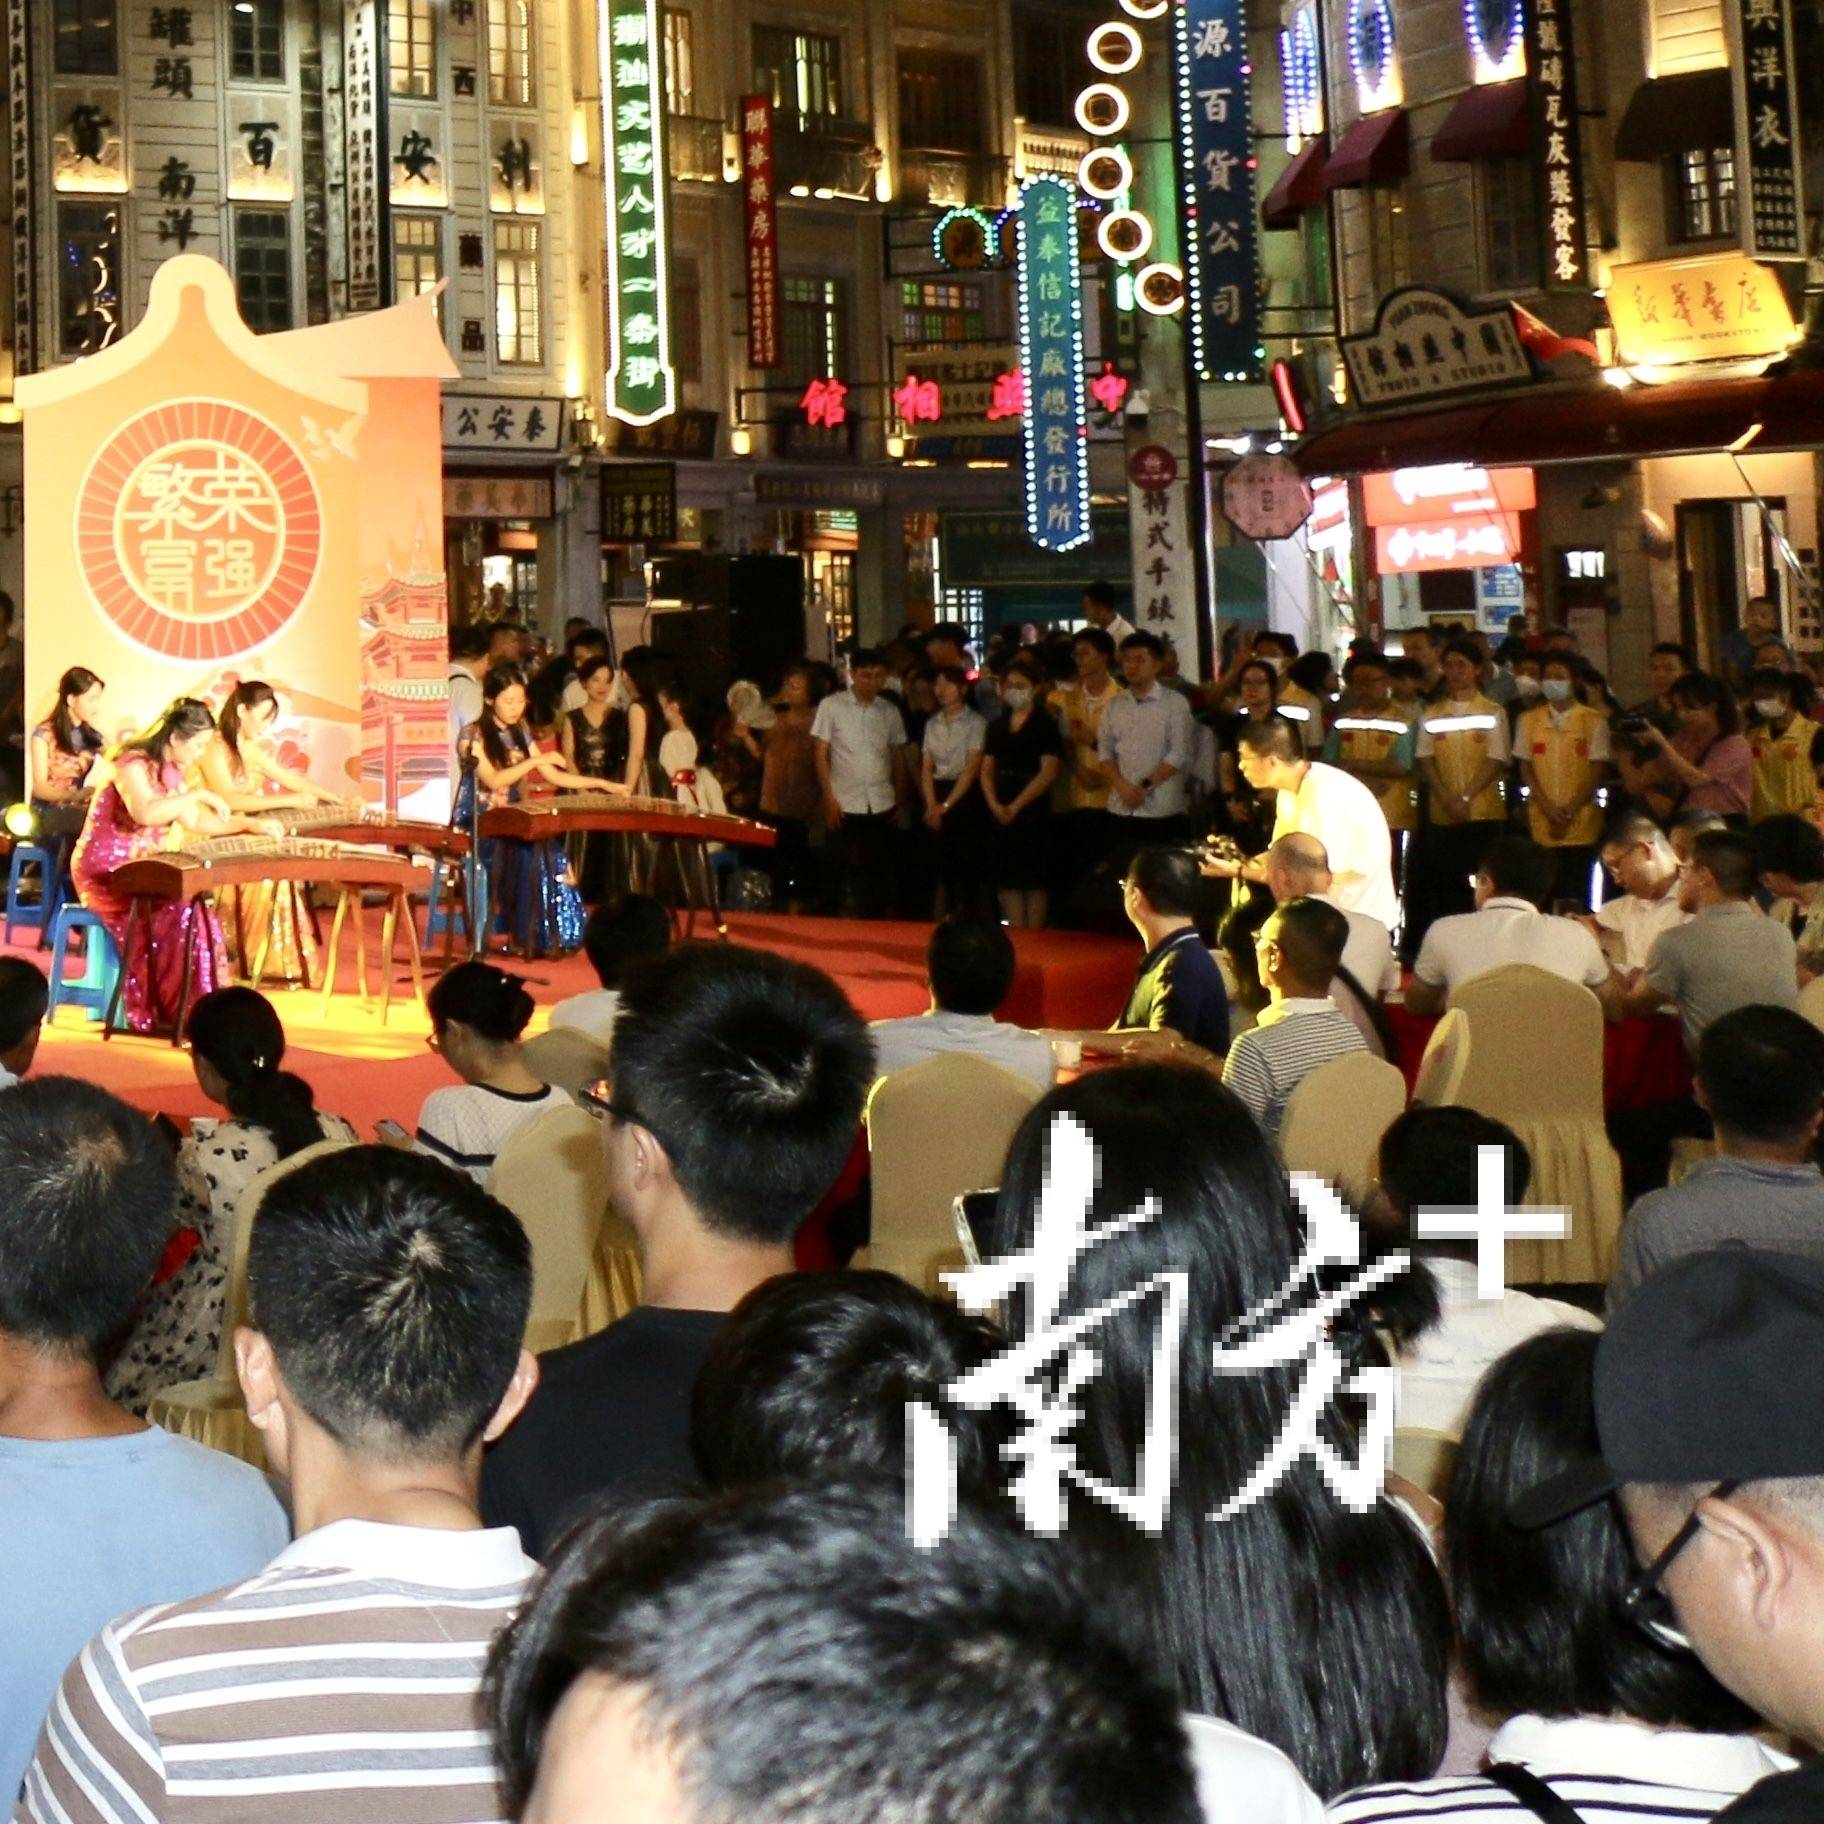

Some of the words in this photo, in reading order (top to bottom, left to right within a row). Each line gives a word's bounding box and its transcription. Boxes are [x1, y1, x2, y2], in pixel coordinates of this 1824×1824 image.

[613, 13, 661, 390] 潮汕文艺人才一条街
[139, 538, 256, 615] 富强
